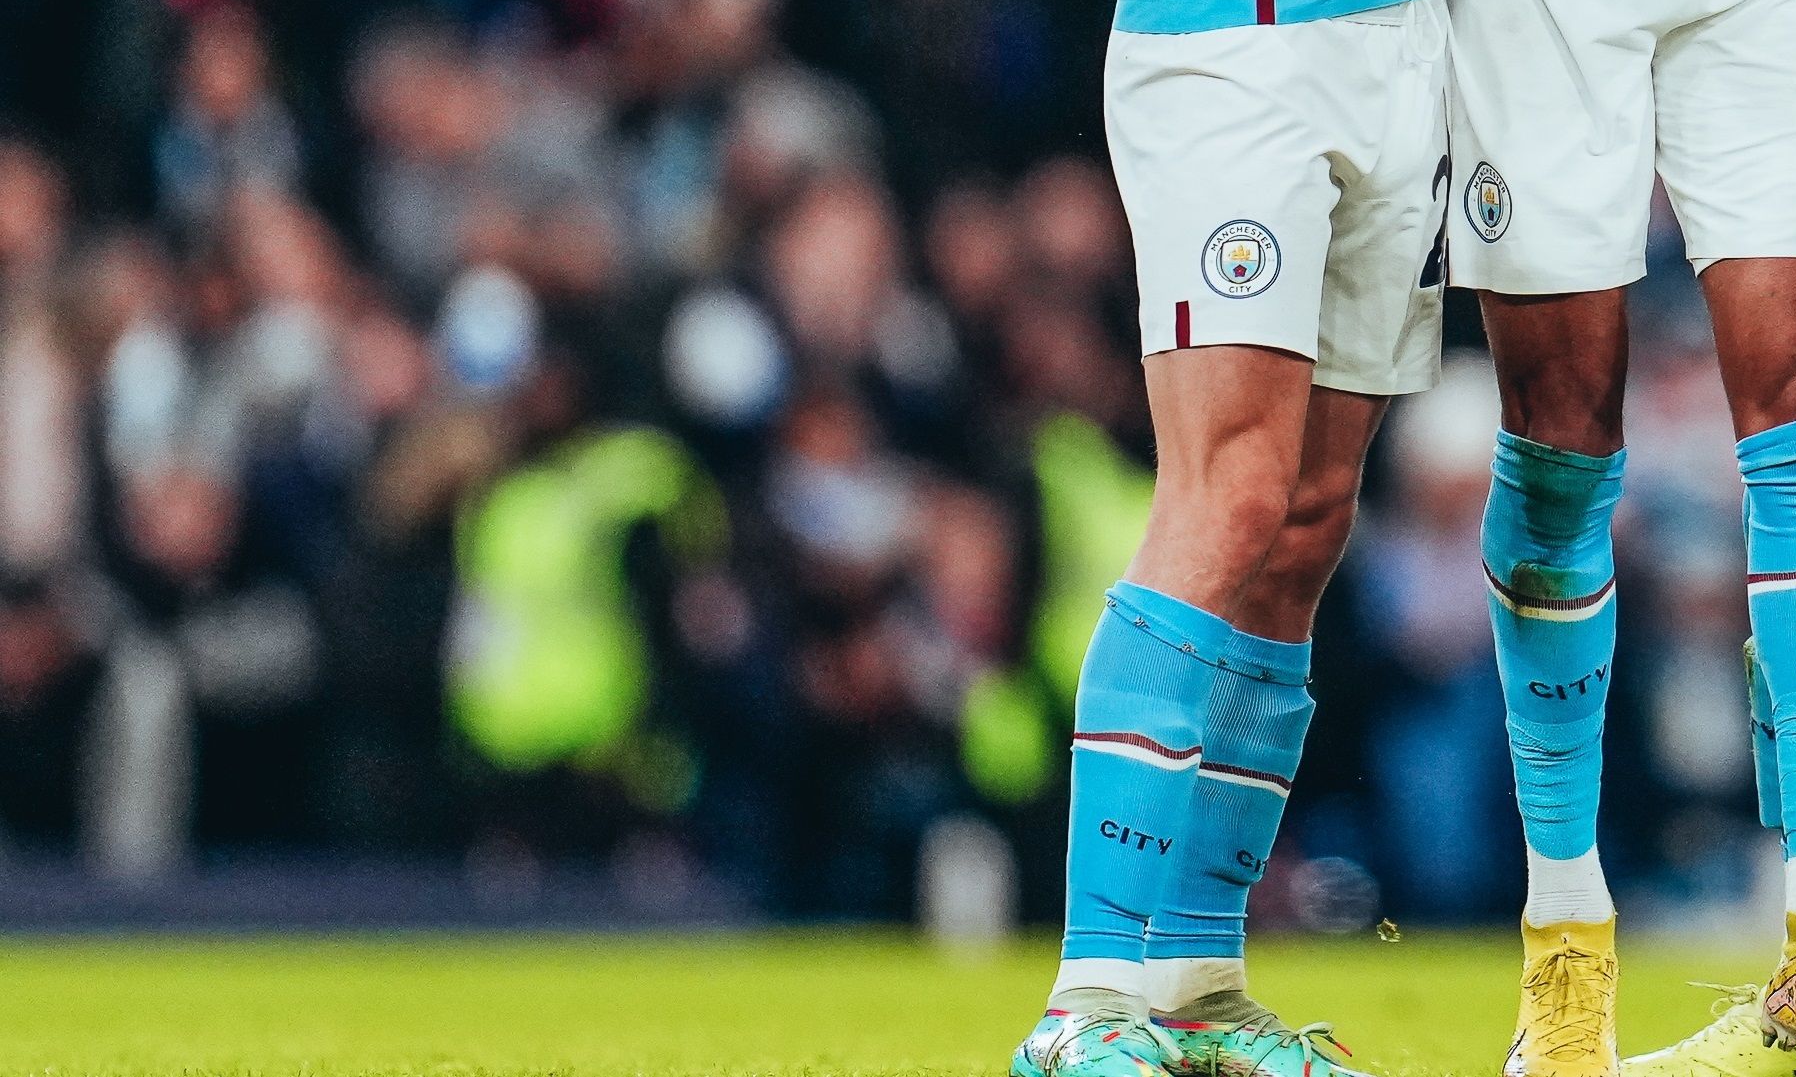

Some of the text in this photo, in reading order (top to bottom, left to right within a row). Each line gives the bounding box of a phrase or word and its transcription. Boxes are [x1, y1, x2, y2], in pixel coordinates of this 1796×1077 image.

[1210, 226, 1272, 252] MANCHESTER
[1484, 228, 1497, 237] CITY
[1228, 285, 1251, 294] CITY
[1528, 664, 1607, 701] CITY
[1100, 819, 1173, 855] CITY
